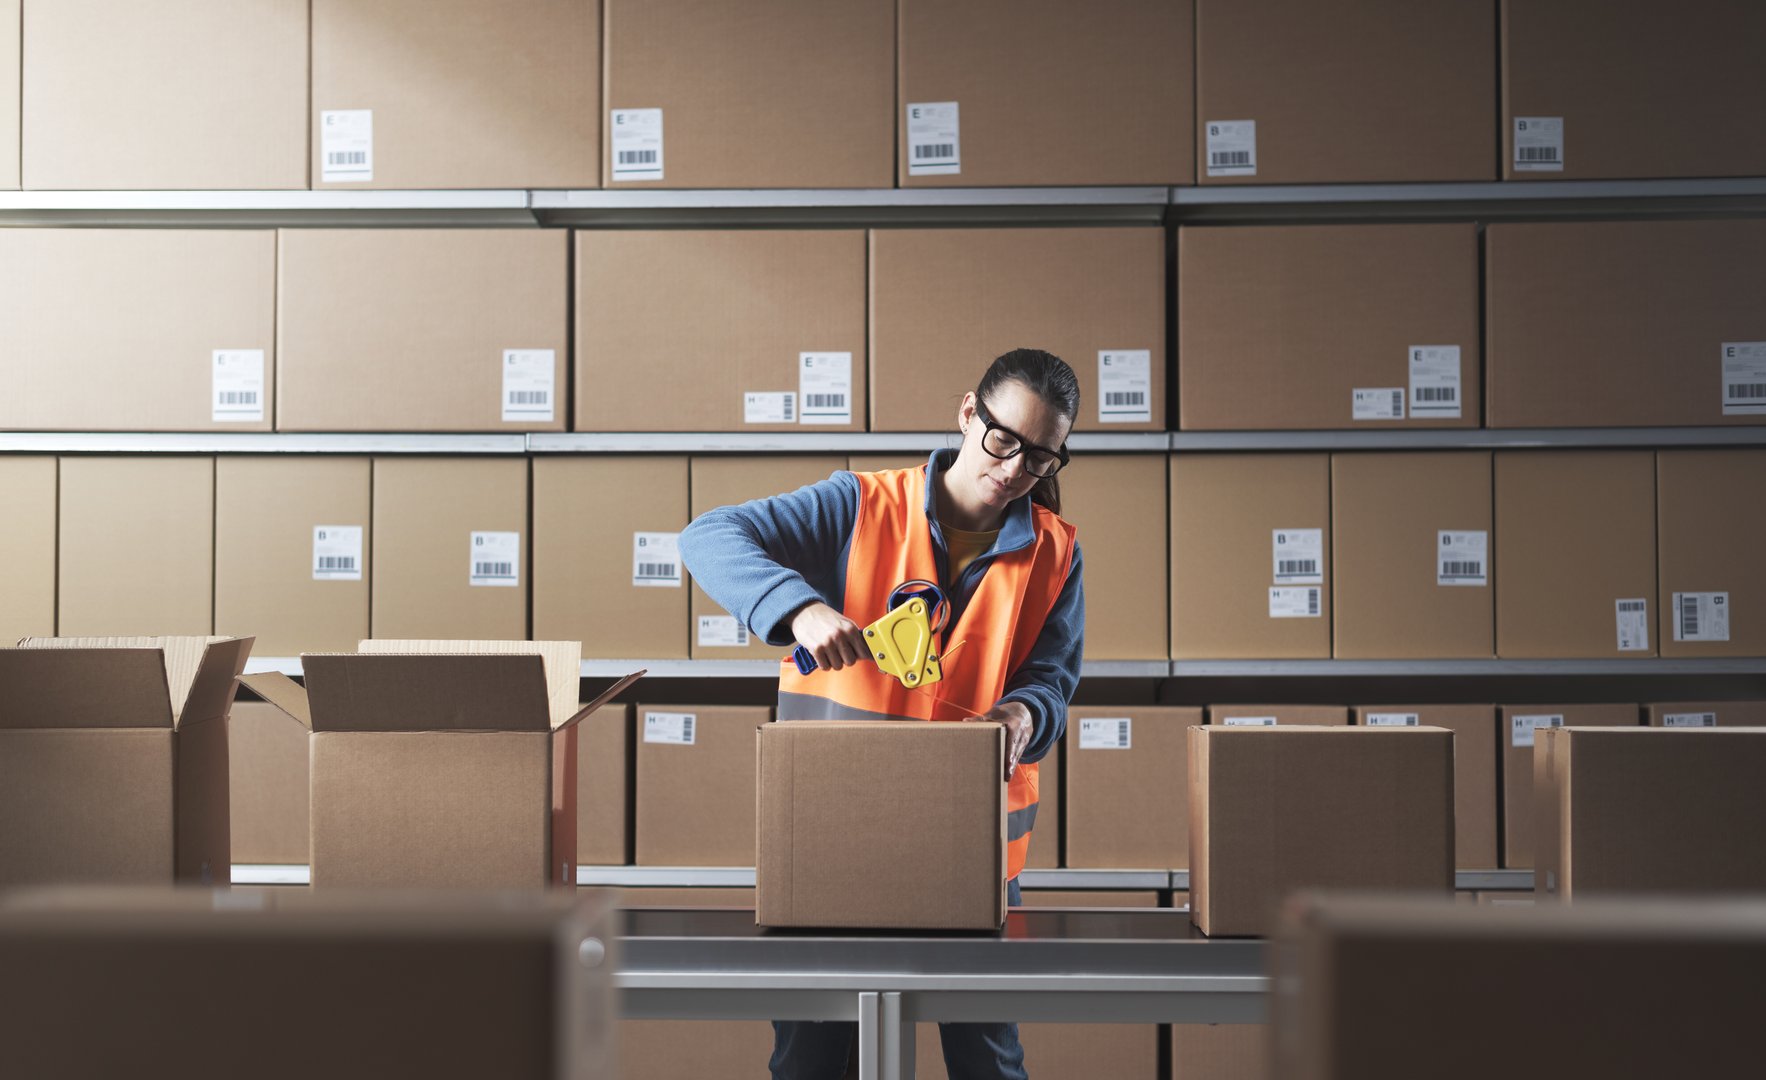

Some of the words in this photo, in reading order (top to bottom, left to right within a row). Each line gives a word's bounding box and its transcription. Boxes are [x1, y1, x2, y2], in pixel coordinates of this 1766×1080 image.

[912, 108, 920, 119] E
[326, 115, 334, 125] E
[616, 114, 624, 125] E
[1518, 121, 1527, 131] B
[1726, 347, 1735, 357] E
[805, 357, 812, 367] E
[1104, 355, 1111, 366] E
[639, 537, 647, 547] B
[1713, 596, 1724, 605] B
